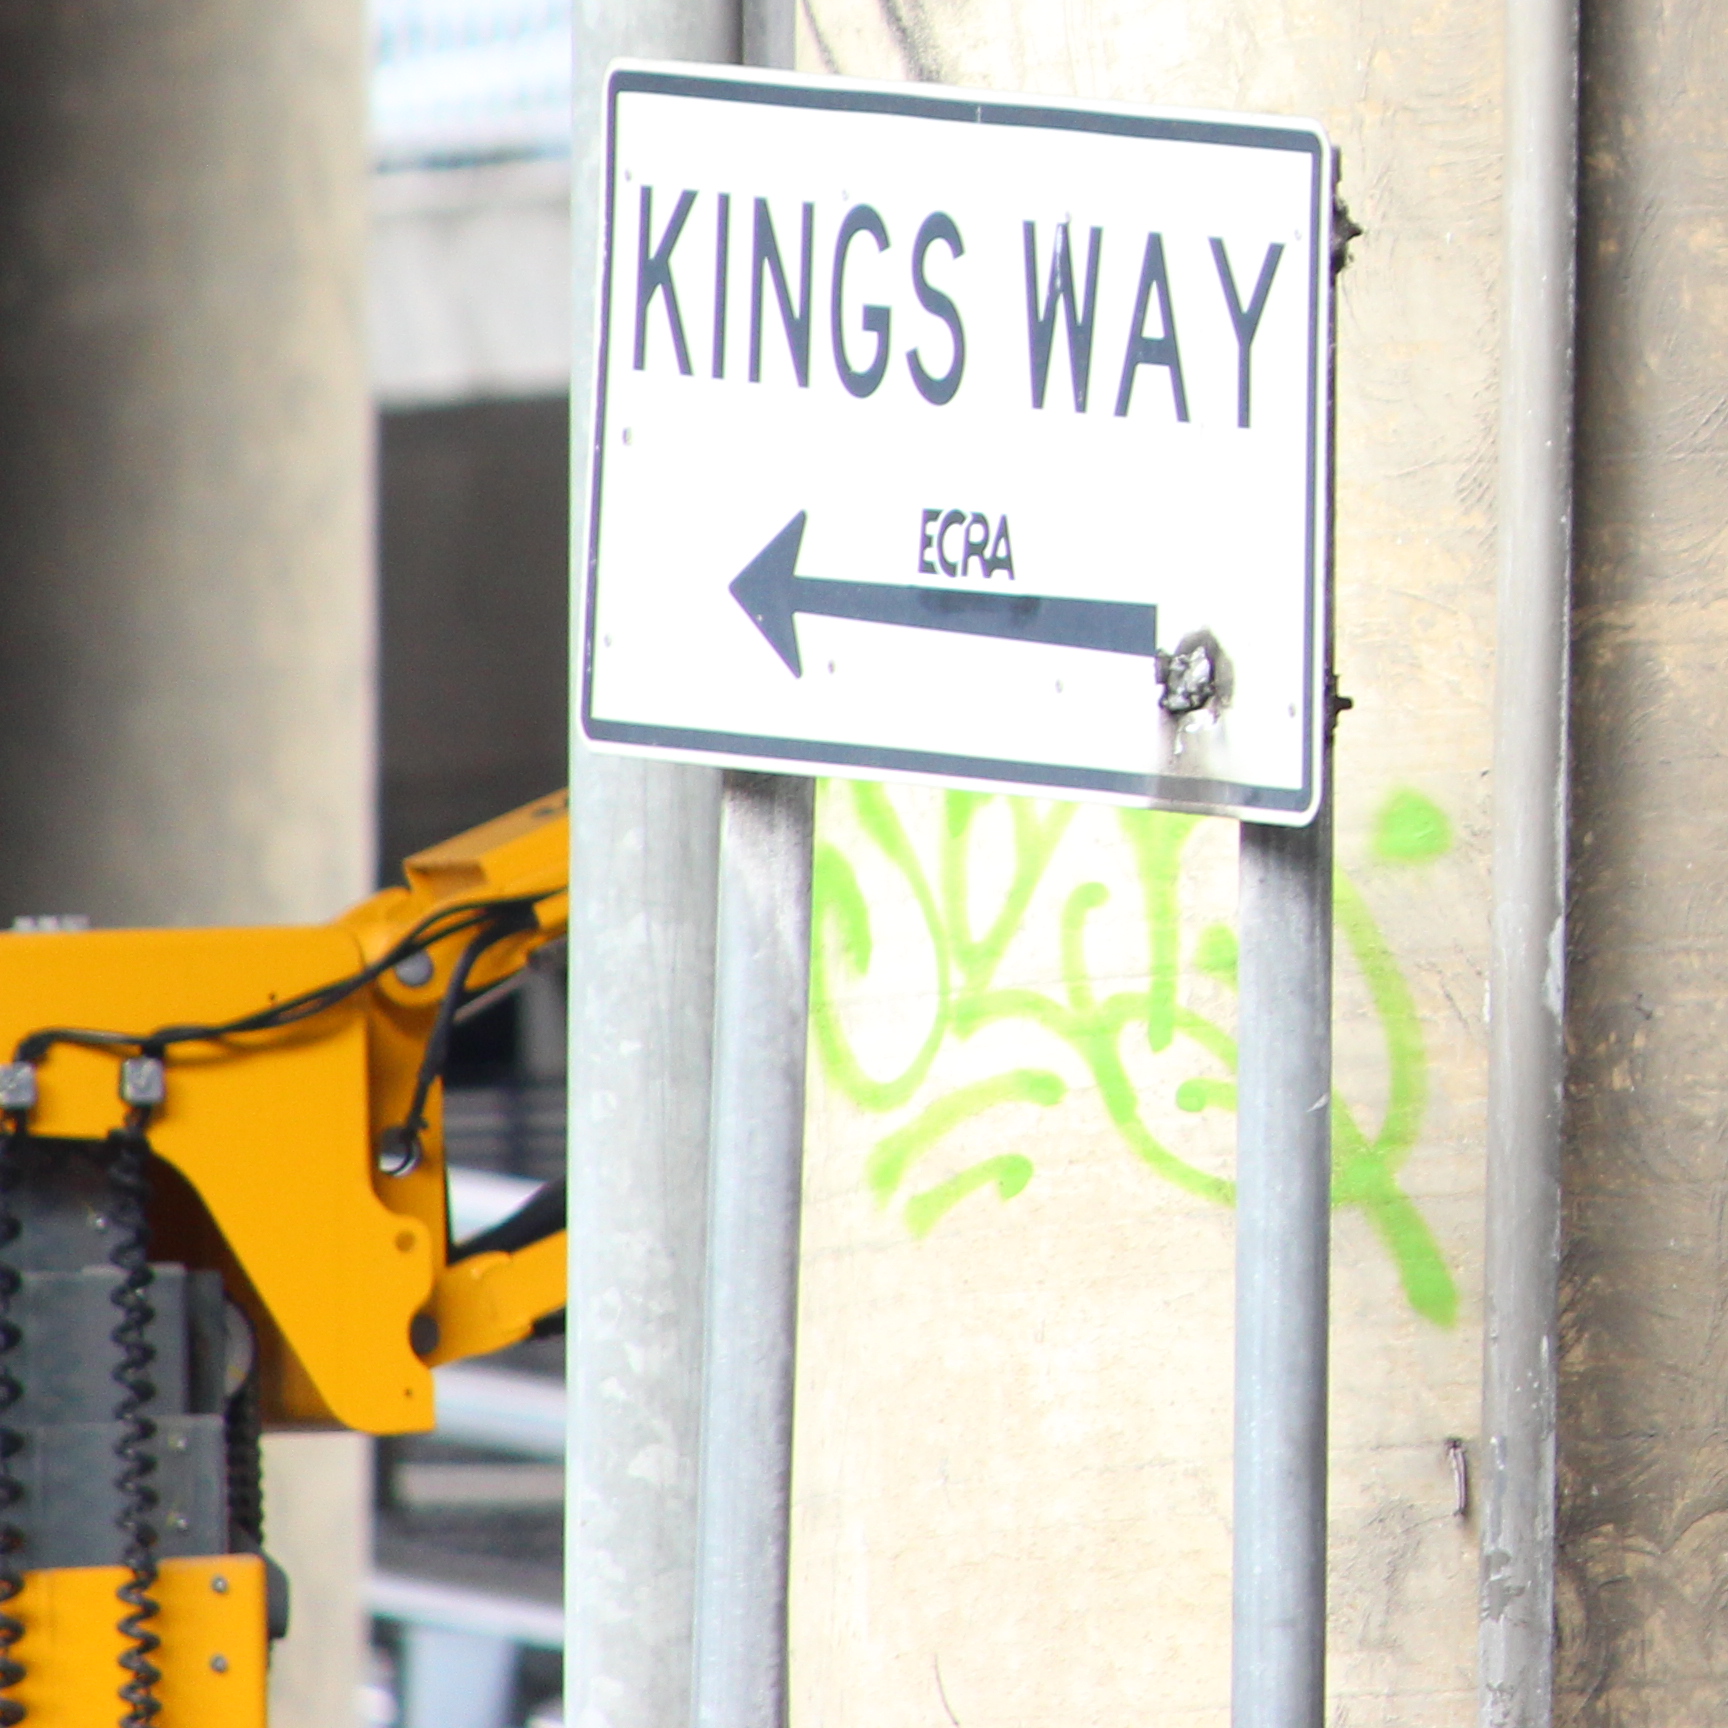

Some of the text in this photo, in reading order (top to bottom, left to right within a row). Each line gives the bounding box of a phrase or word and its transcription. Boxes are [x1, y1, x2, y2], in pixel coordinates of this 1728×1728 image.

[633, 186, 1284, 428] KINGS WAY
[919, 509, 1015, 580] ECRA
